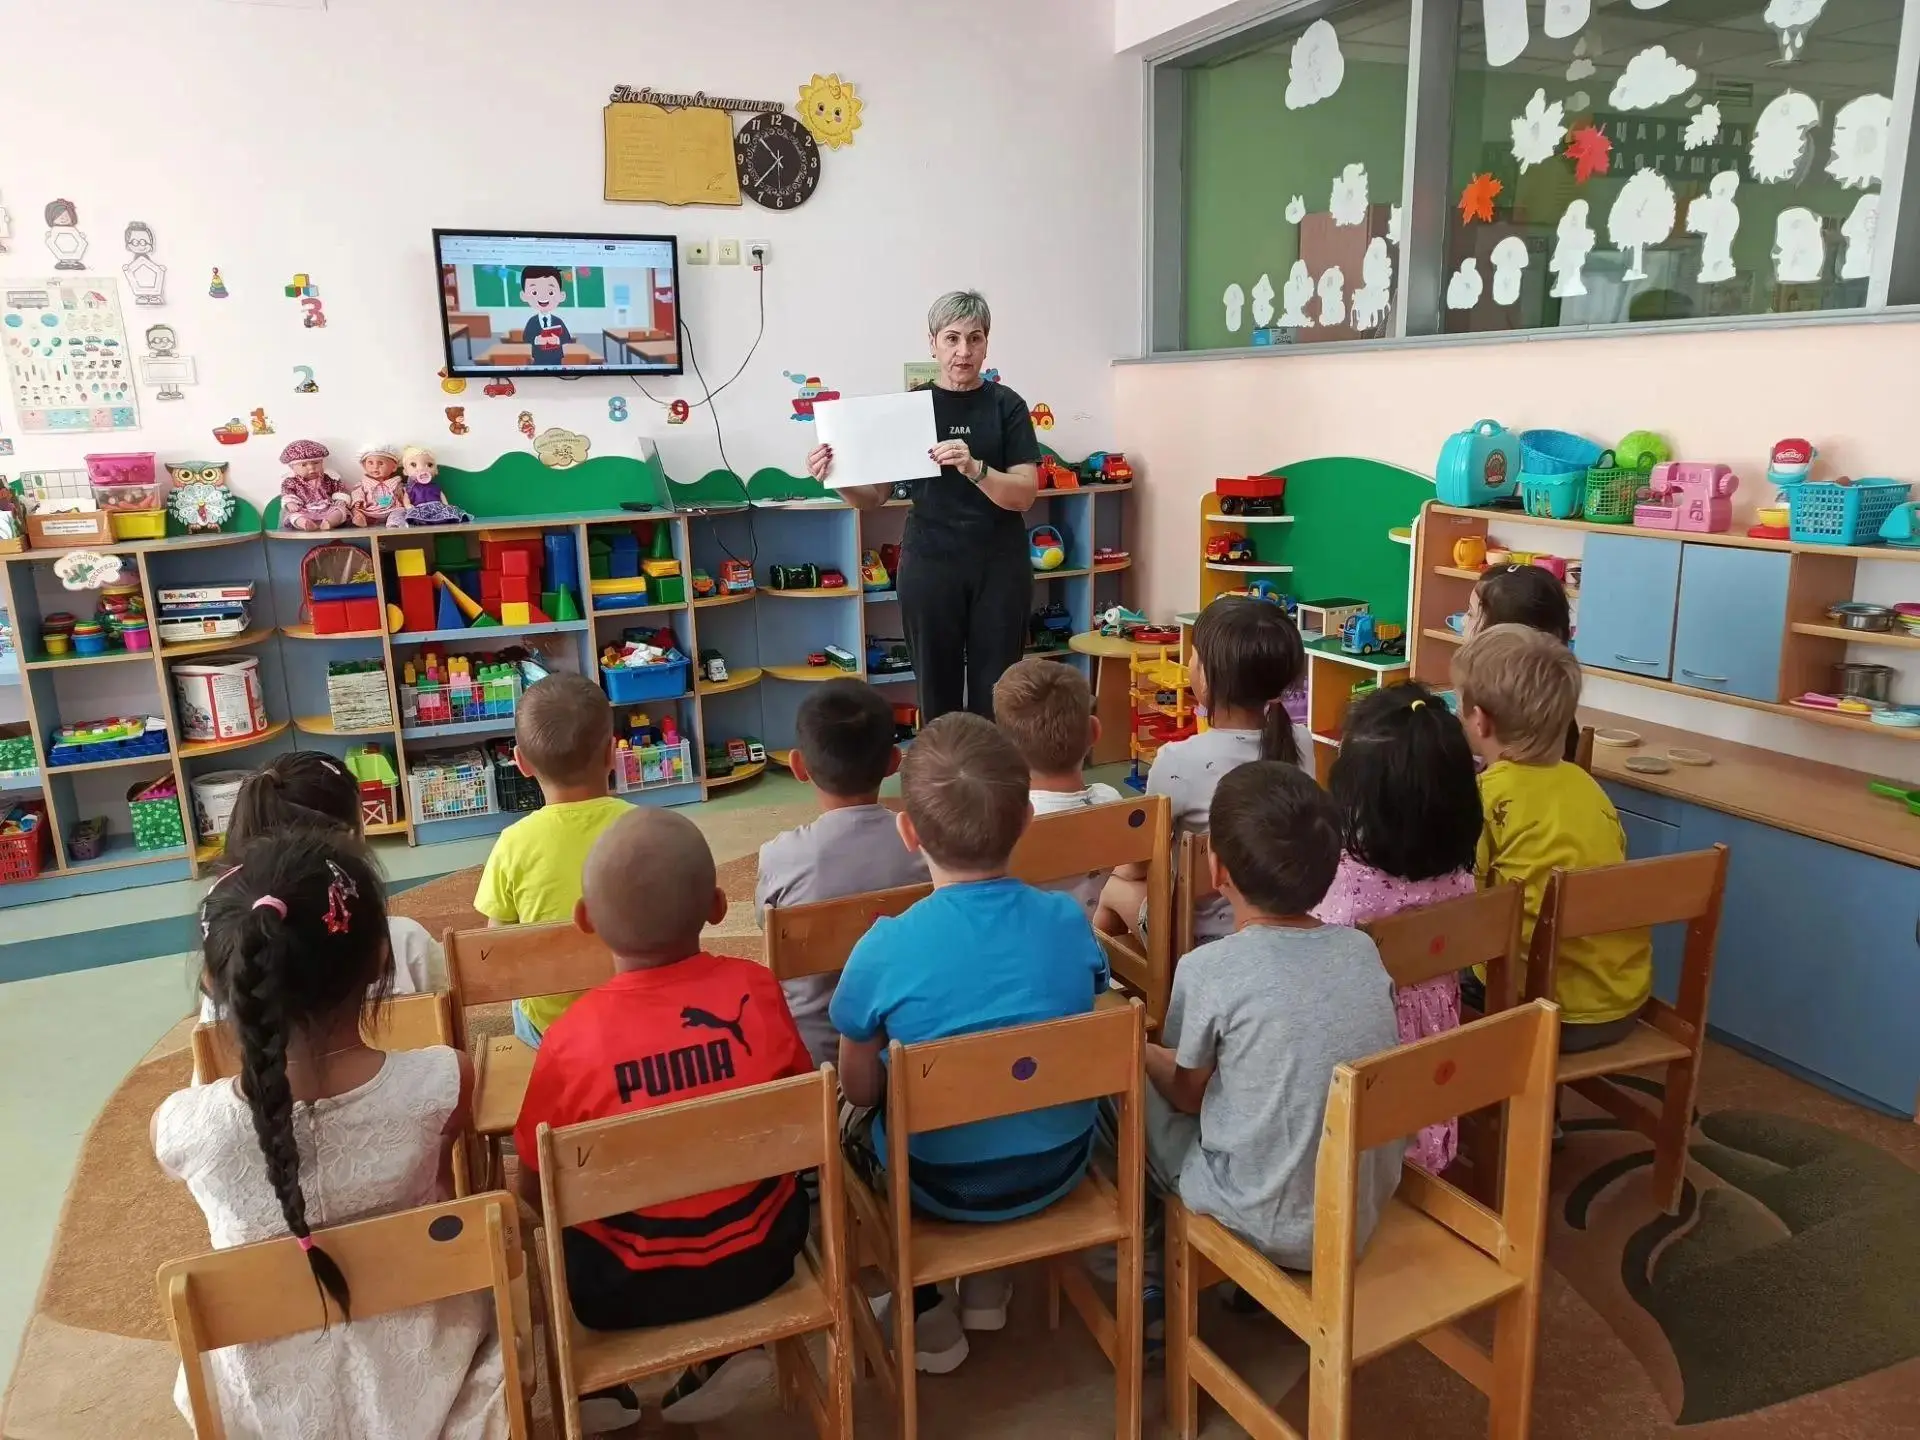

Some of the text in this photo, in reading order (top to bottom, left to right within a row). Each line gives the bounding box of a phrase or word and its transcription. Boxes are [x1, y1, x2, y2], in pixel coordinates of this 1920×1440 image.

[752, 120, 760, 130] 11
[771, 115, 782, 126] 12
[793, 122, 798, 132] 1
[739, 133, 750, 144] 10
[805, 136, 812, 147] 2
[737, 154, 744, 165] 9
[811, 157, 817, 168] 3
[742, 174, 749, 185] 8
[806, 176, 813, 187] 4
[758, 191, 764, 202] 7
[776, 197, 783, 207] 6
[795, 192, 801, 203] 5
[608, 396, 628, 422] 8
[671, 399, 689, 423] 9
[949, 426, 971, 434] ZARA
[614, 1038, 735, 1104] PUMA
